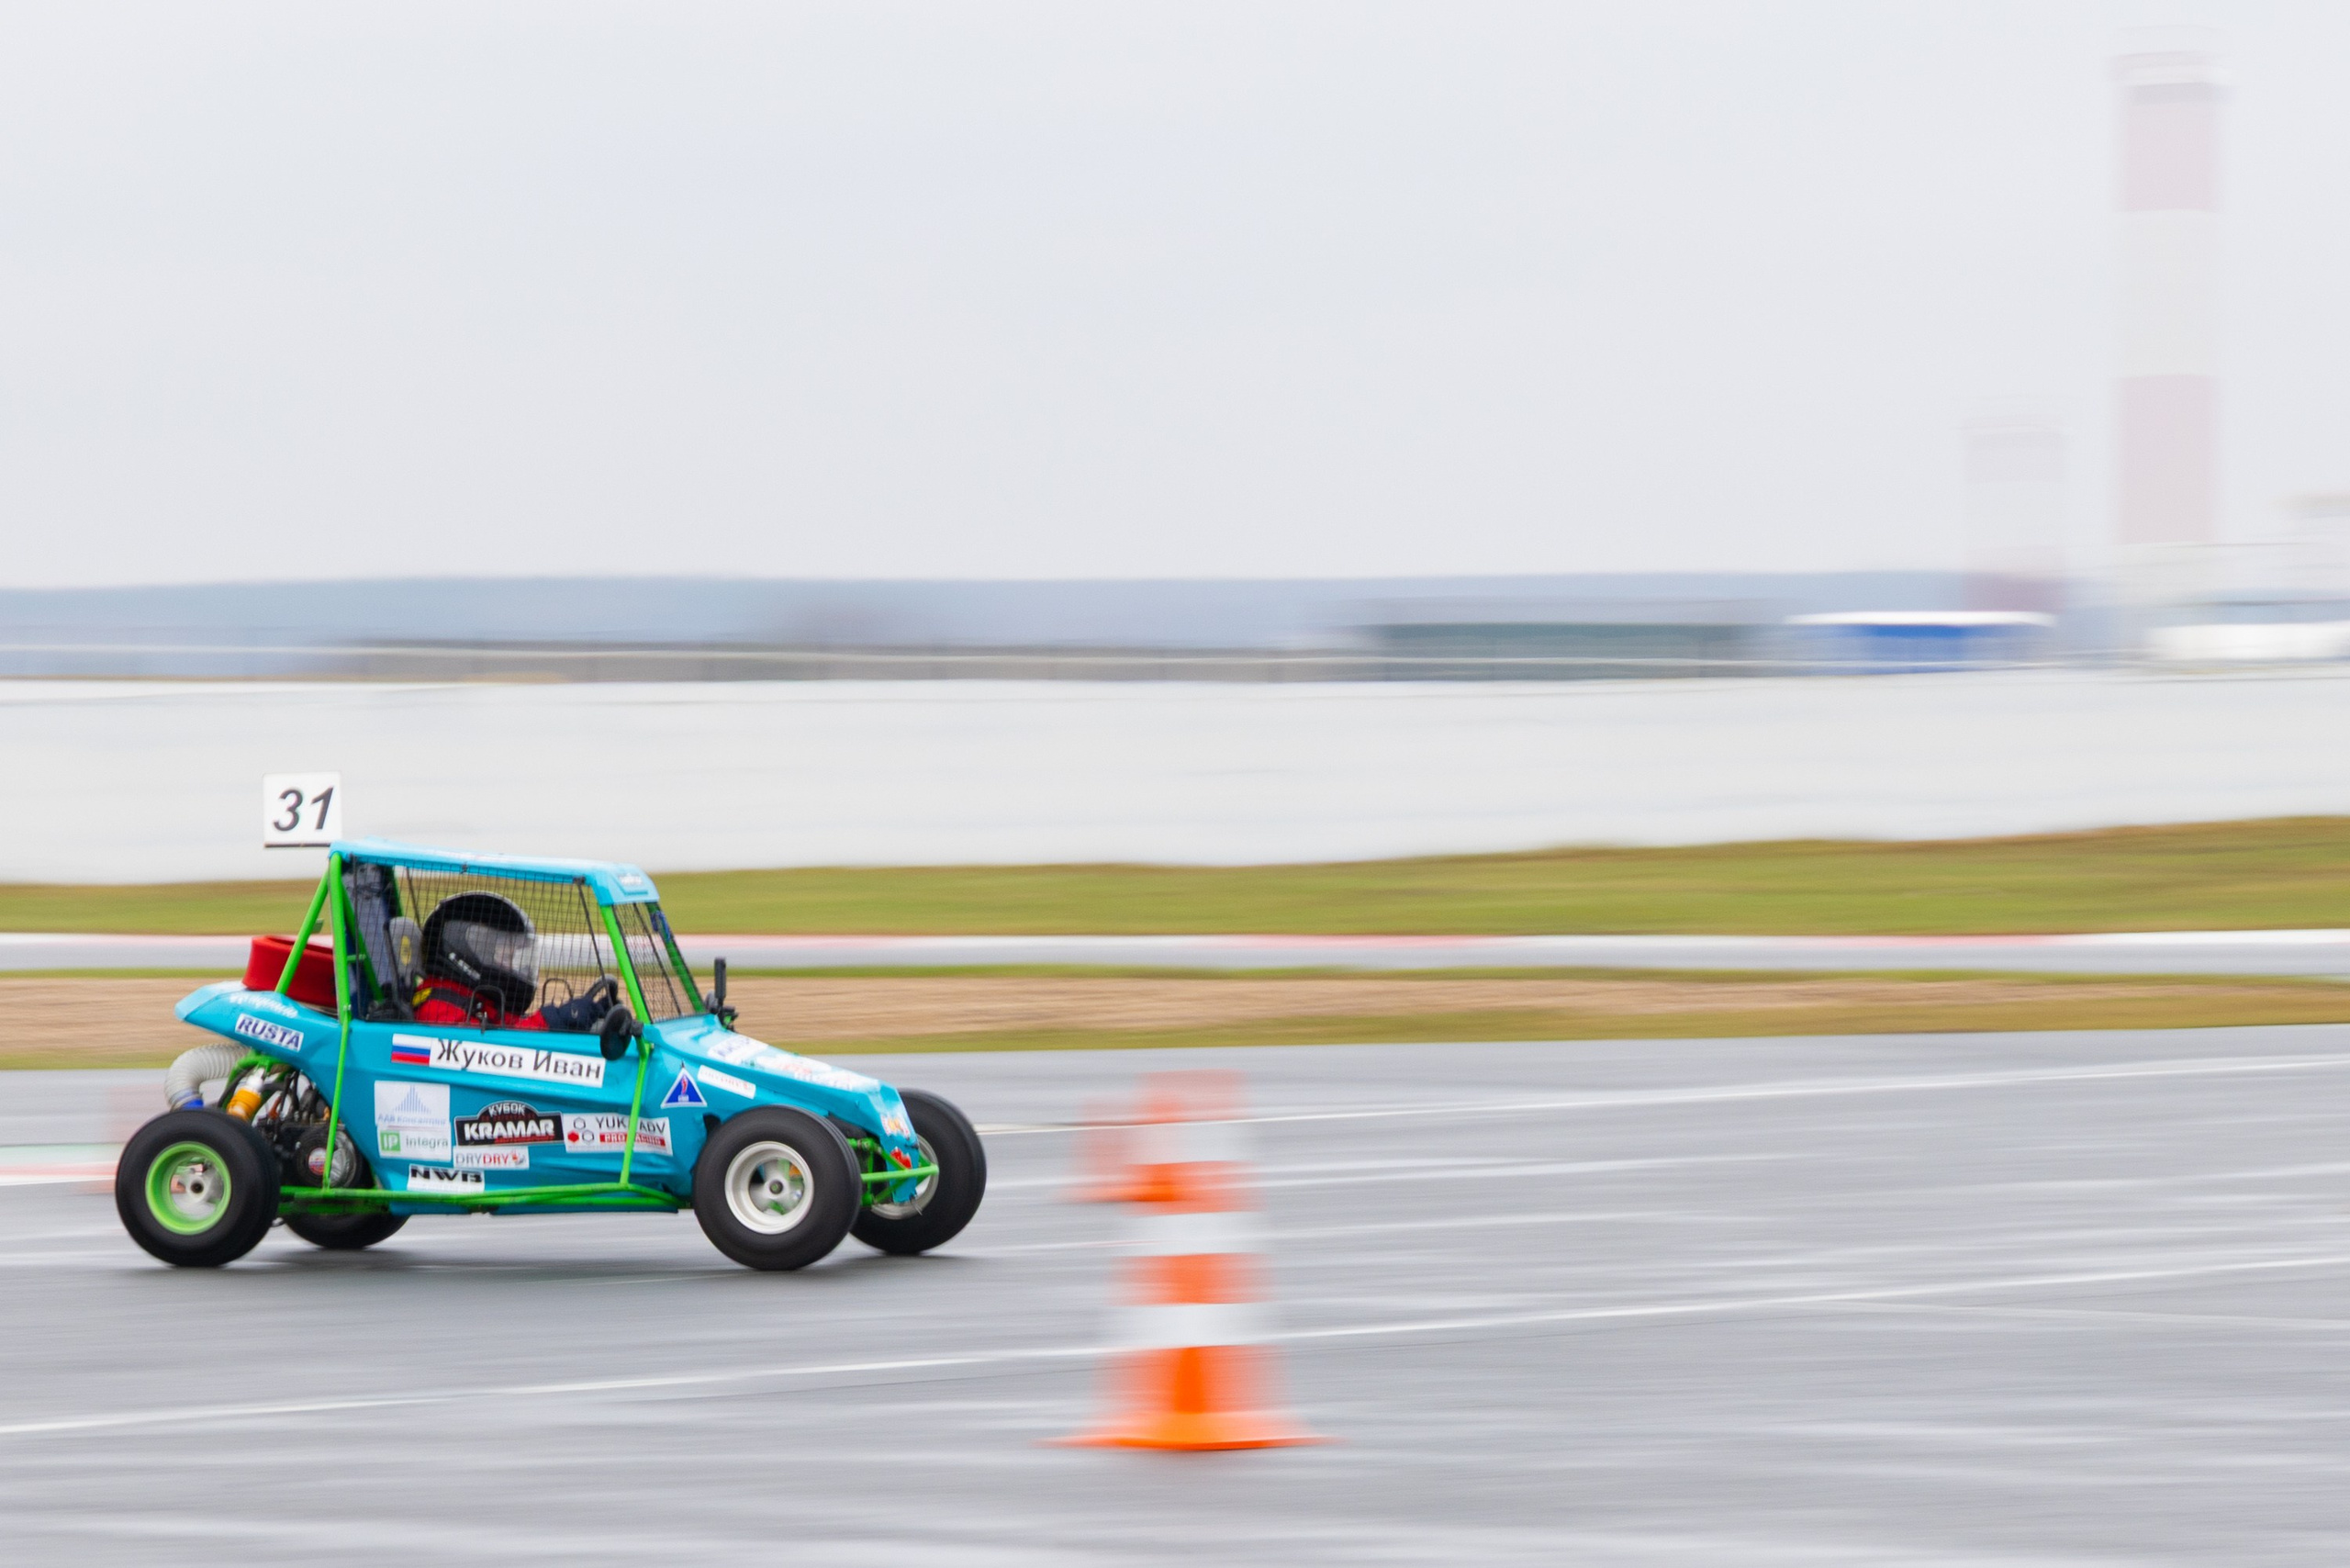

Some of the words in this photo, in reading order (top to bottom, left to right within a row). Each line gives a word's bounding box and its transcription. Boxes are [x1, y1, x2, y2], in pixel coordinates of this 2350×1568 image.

[273, 787, 333, 831] 31
[238, 1016, 300, 1048] RUSTA
[437, 1037, 522, 1069] Жуков
[532, 1049, 601, 1080] Иван
[488, 1103, 526, 1117] КУБОК
[464, 1118, 554, 1141] KRAMAR
[596, 1116, 666, 1133] YUKADV
[383, 1134, 398, 1150] IP
[406, 1135, 448, 1148] integra
[410, 1167, 483, 1182] NWB
